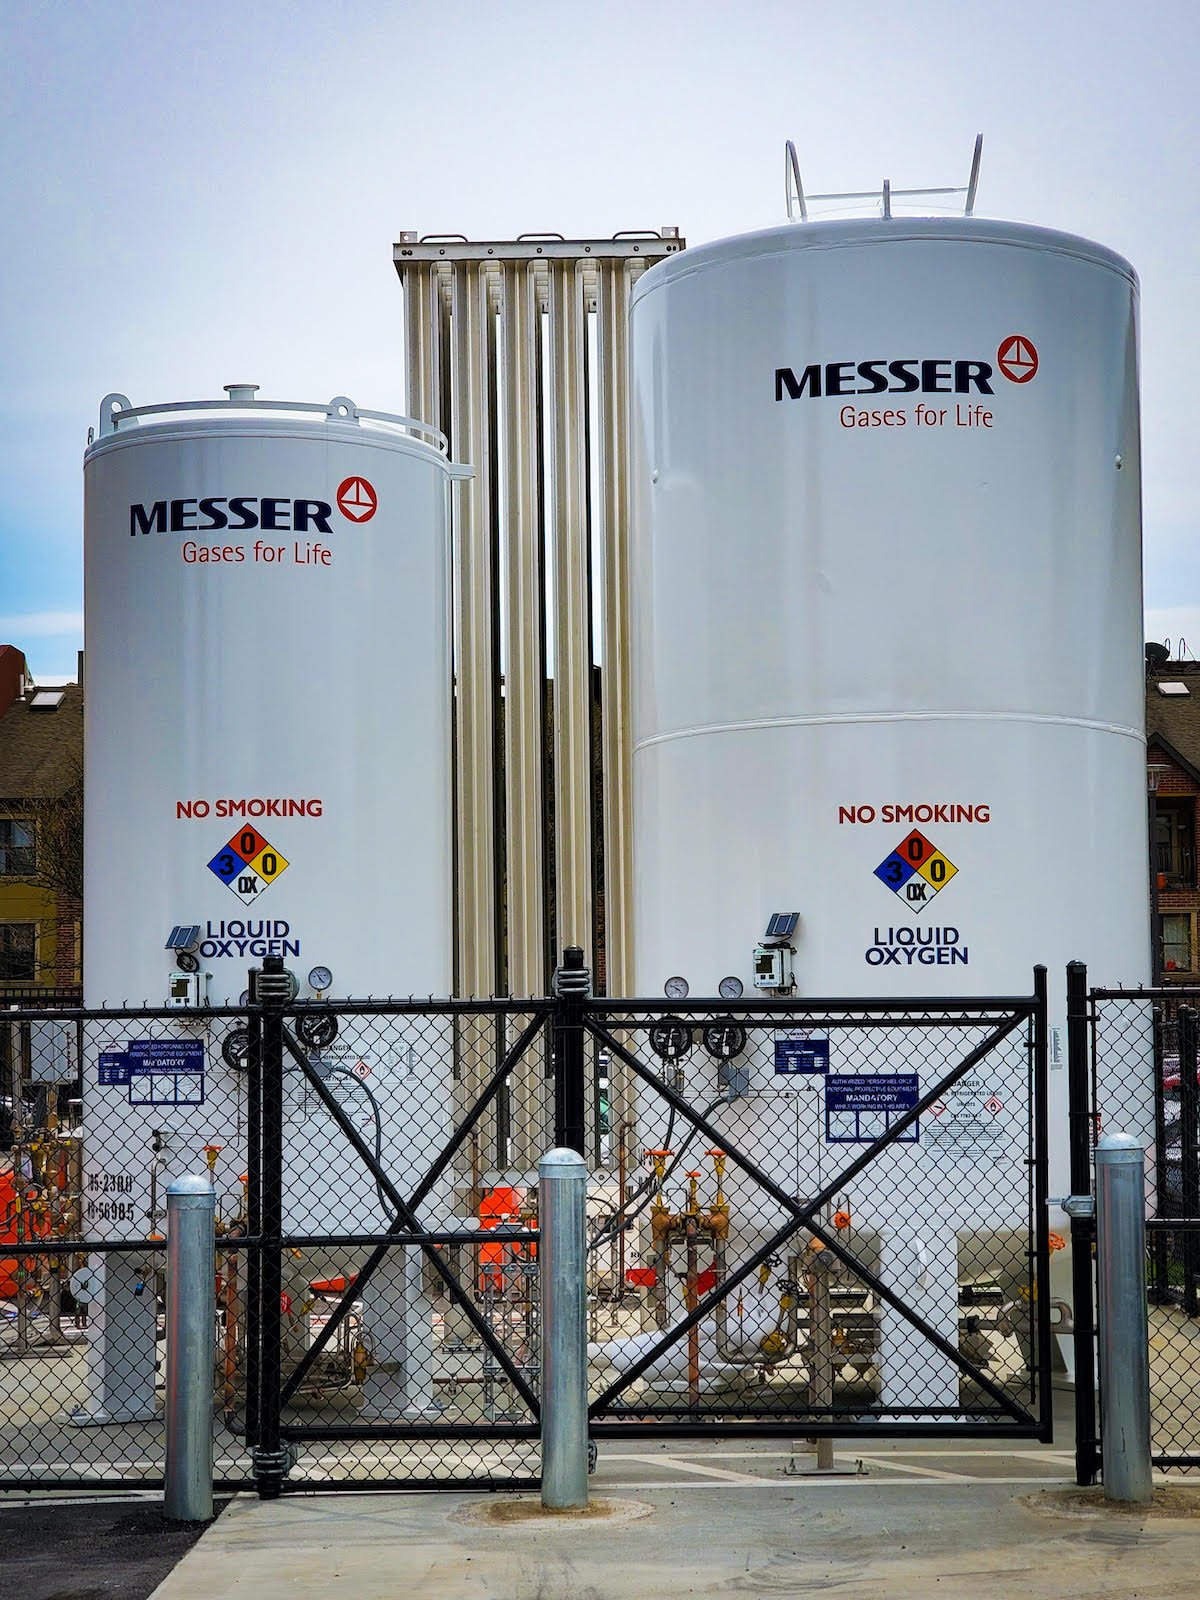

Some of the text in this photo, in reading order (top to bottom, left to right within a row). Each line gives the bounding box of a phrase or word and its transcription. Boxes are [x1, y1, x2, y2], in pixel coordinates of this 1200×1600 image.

[774, 359, 995, 402] MESSER
[839, 403, 994, 428] Gases for Life
[129, 497, 334, 537] MESSER
[182, 540, 333, 566] Gases for Life
[176, 798, 323, 819] NO SMOKING
[838, 804, 991, 824] NO SMOKING
[240, 832, 255, 855] 0
[907, 837, 923, 861] 0
[218, 853, 277, 876] 3 0
[886, 859, 946, 883] 3 0
[238, 876, 258, 893] OX
[906, 883, 928, 901] OX
[206, 919, 290, 939] LIQUID
[873, 926, 960, 946] LIQUID
[199, 939, 300, 958] OXYGEN
[864, 946, 969, 966] OXYGEN
[845, 1094, 898, 1102] MANDATORY
